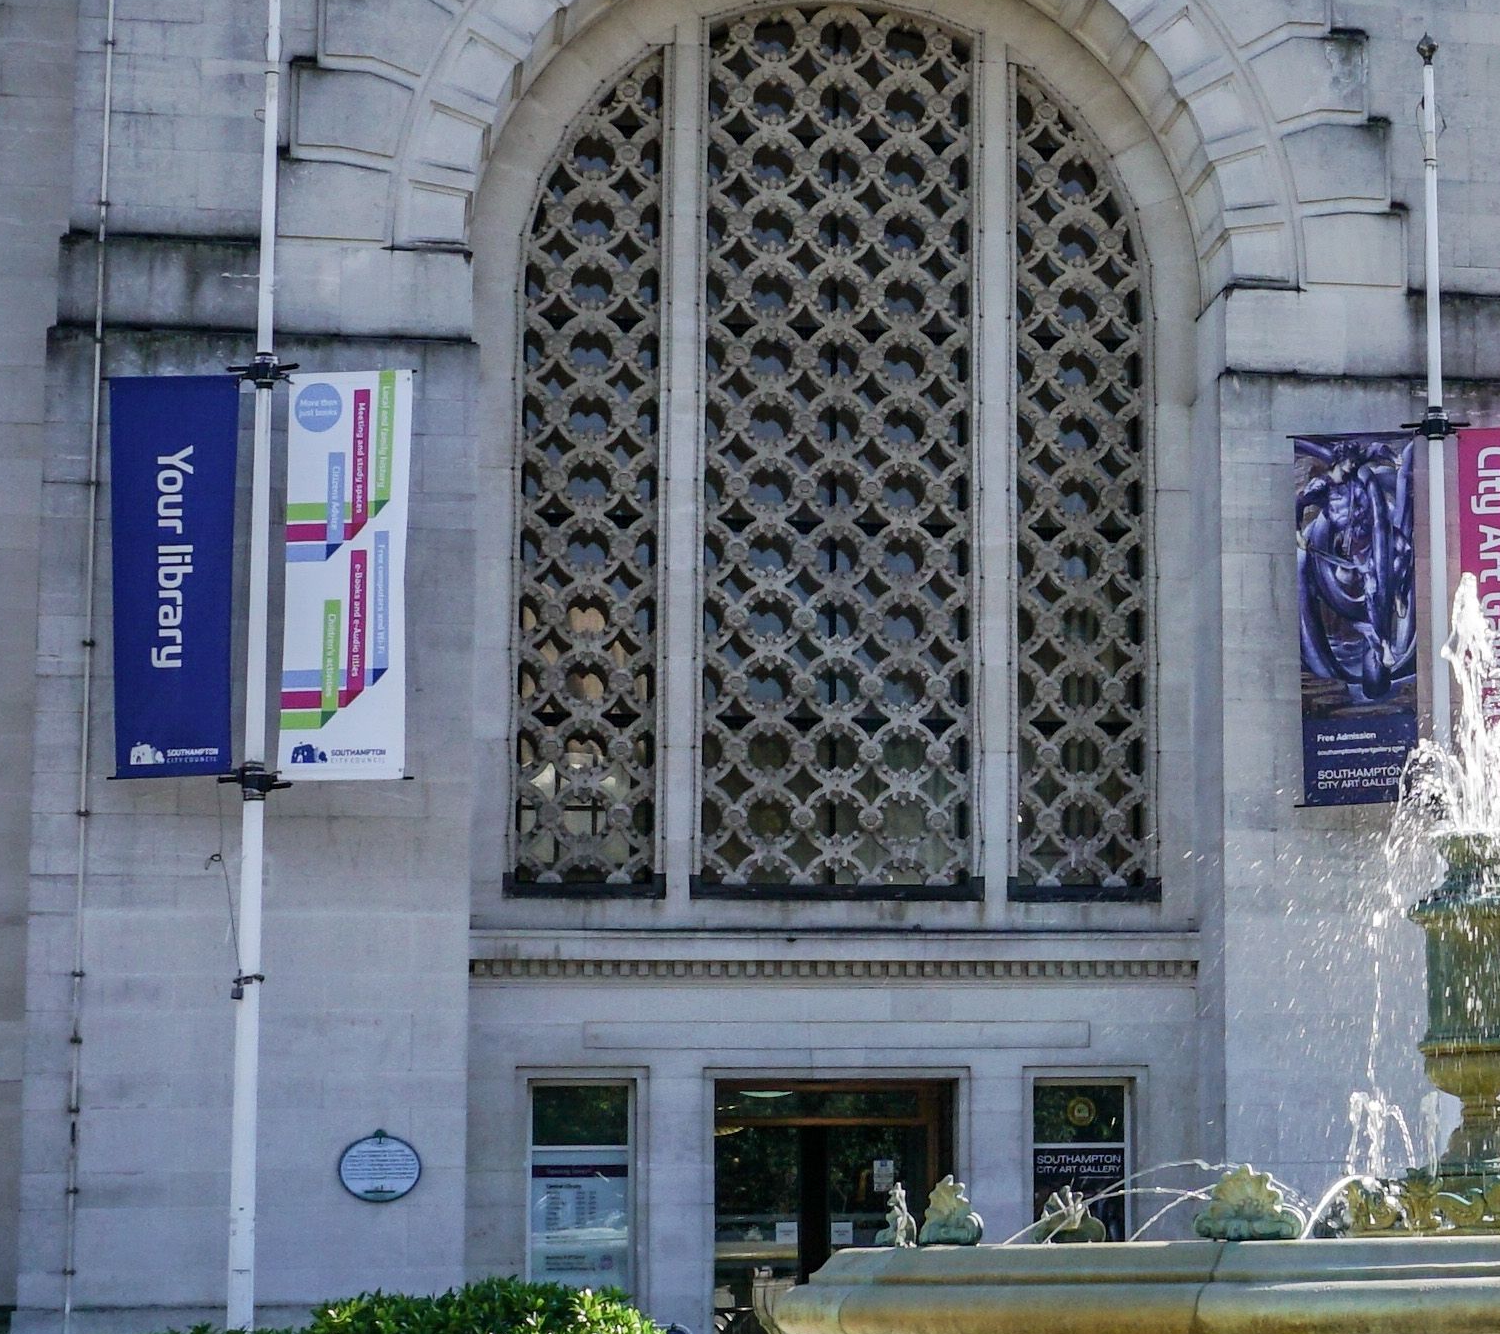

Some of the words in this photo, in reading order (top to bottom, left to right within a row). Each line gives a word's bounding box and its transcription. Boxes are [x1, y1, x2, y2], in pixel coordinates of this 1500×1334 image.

[381, 386, 390, 408] Local
[316, 408, 337, 416] books
[356, 402, 366, 438] Meeting
[381, 410, 389, 426] and
[357, 440, 366, 456] and
[378, 428, 389, 455] family
[355, 457, 365, 482] study
[377, 456, 387, 488] history
[157, 445, 193, 534] Your
[332, 466, 341, 500] Citizens
[355, 484, 364, 514] spaces
[331, 501, 340, 531] Advice
[377, 544, 386, 564] Free
[353, 563, 362, 600] e-Books
[376, 566, 385, 612] computers
[151, 544, 194, 668] library
[353, 601, 362, 618] and
[376, 613, 385, 630] and
[352, 619, 361, 653] e-Audio
[351, 654, 360, 677] titles
[325, 658, 335, 697] activities
[1317, 734, 1335, 742] Free
[1336, 732, 1376, 741] Admission
[167, 748, 218, 756] SOUTHAMPTON
[1317, 766, 1404, 779] SOUTHAMPTON
[1318, 781, 1339, 789] CITY
[1341, 779, 1360, 788] ART
[1362, 777, 1401, 786] GALLER
[1037, 1155, 1121, 1164] SOUTHAMPTON
[1080, 1165, 1121, 1173] GALLERY
